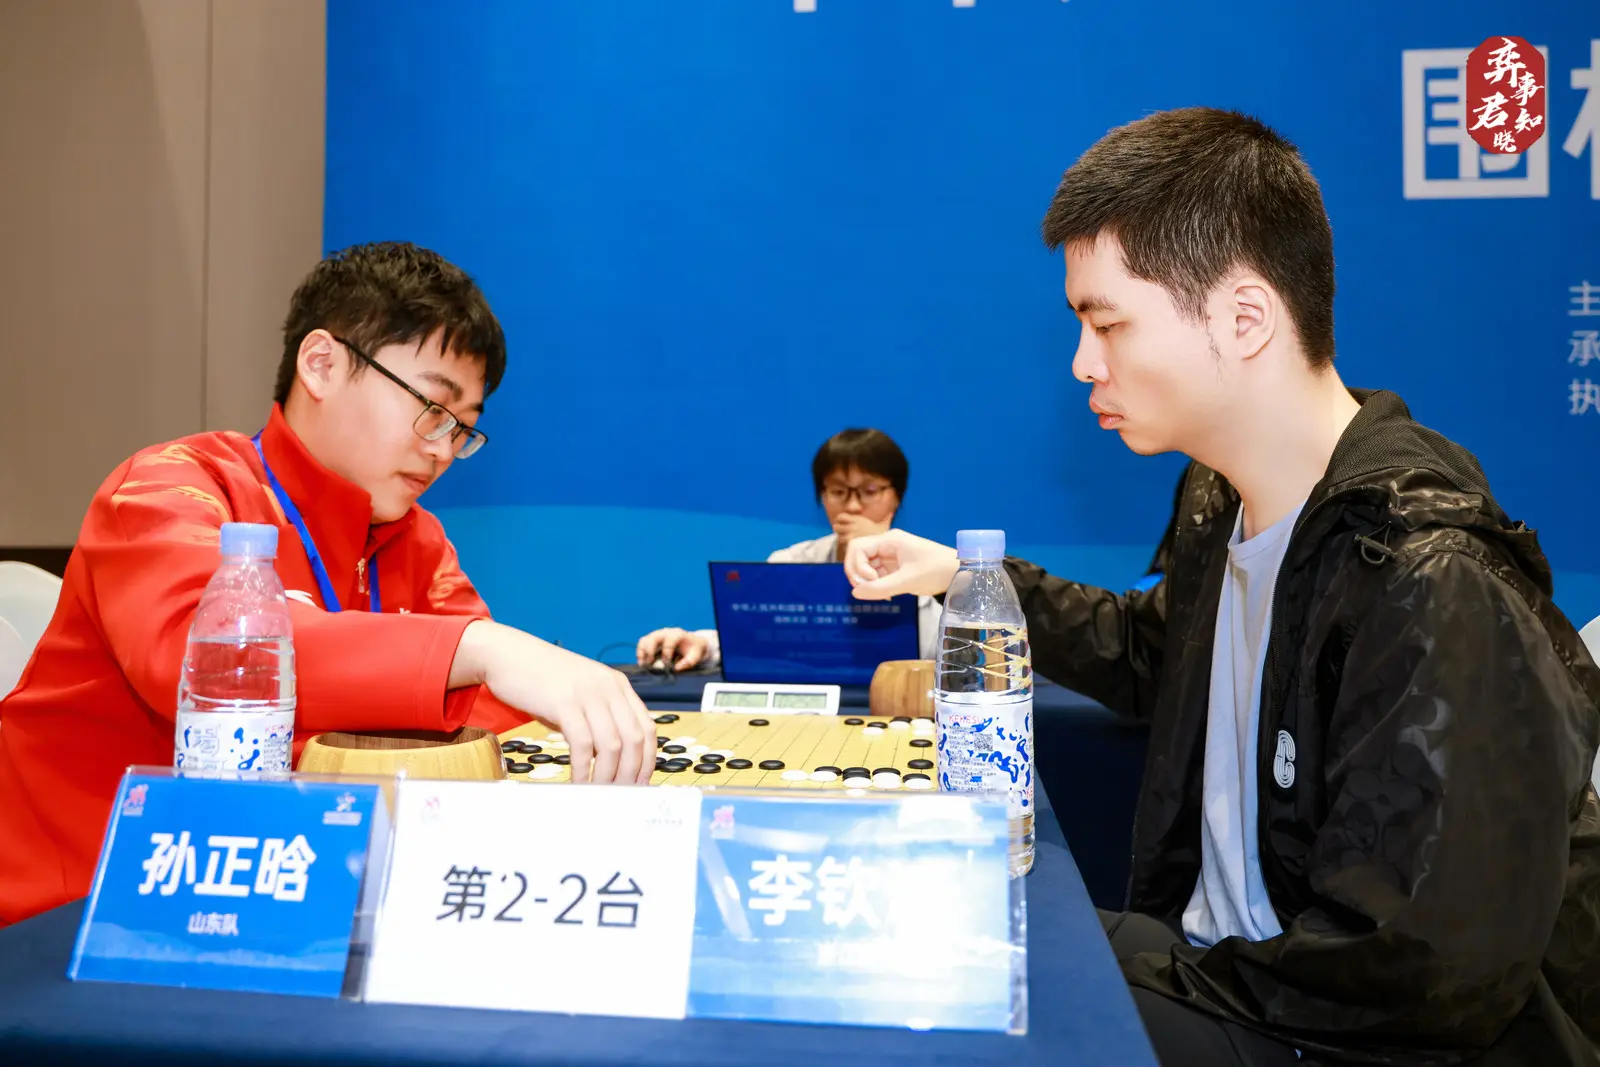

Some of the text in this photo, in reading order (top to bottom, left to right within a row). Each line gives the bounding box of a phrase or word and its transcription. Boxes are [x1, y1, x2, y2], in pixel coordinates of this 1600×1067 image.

[138, 831, 317, 902] 孙正晗
[436, 864, 644, 928] 第2-2台
[748, 854, 881, 928] 李钦
[187, 911, 239, 936] 山东队
